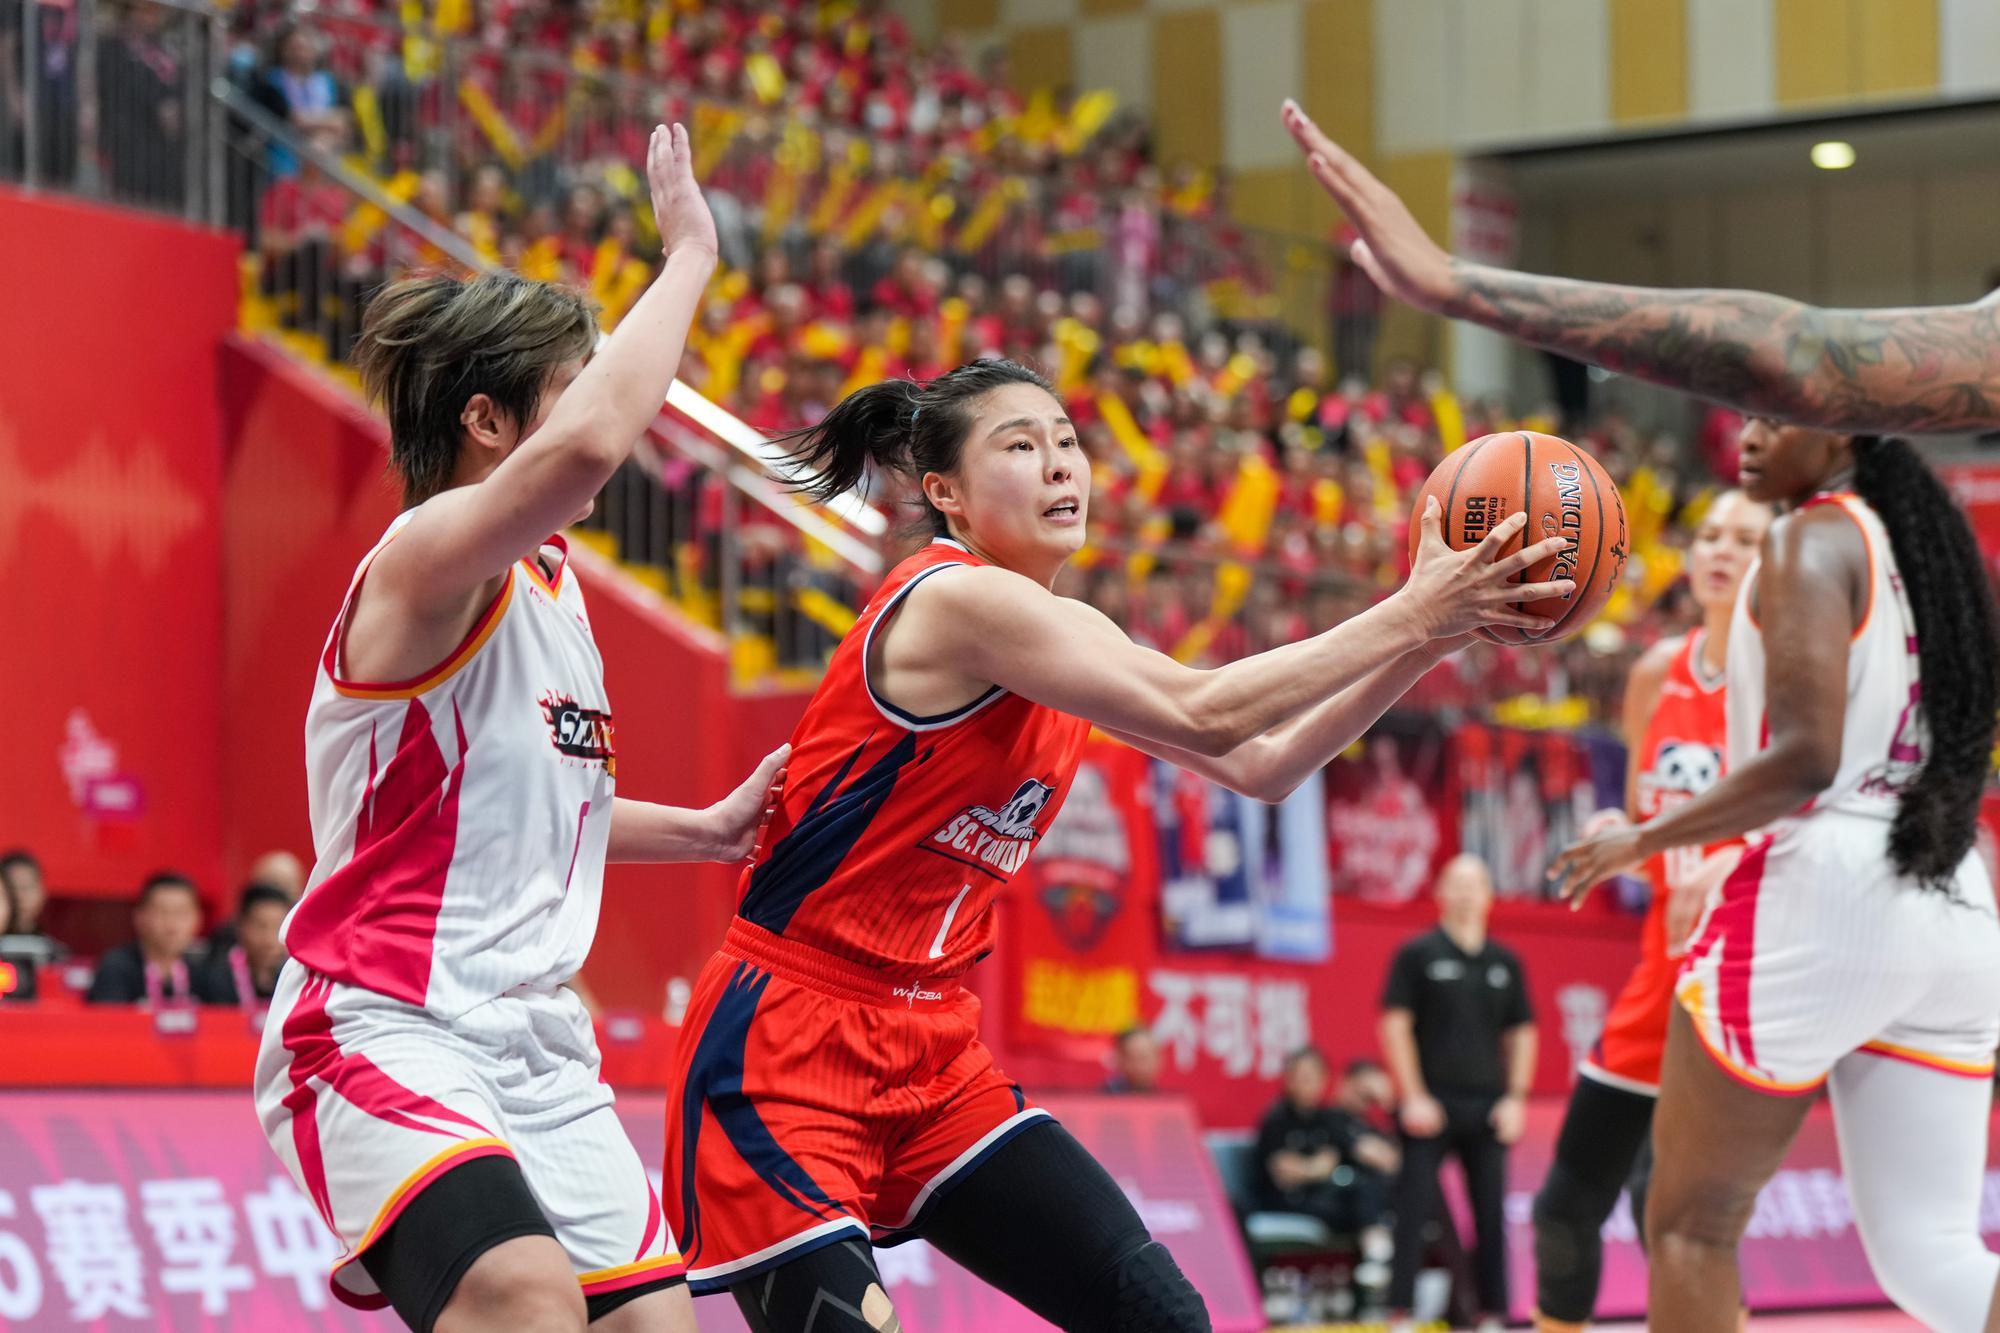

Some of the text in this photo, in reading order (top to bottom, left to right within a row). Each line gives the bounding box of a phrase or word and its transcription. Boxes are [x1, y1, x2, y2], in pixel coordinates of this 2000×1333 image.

[1463, 496, 1487, 543] FIBA
[1486, 497, 1498, 536] PROVED
[1549, 461, 1582, 600] PALDING
[928, 883, 972, 960] 1
[893, 984, 942, 1002] WCBA
